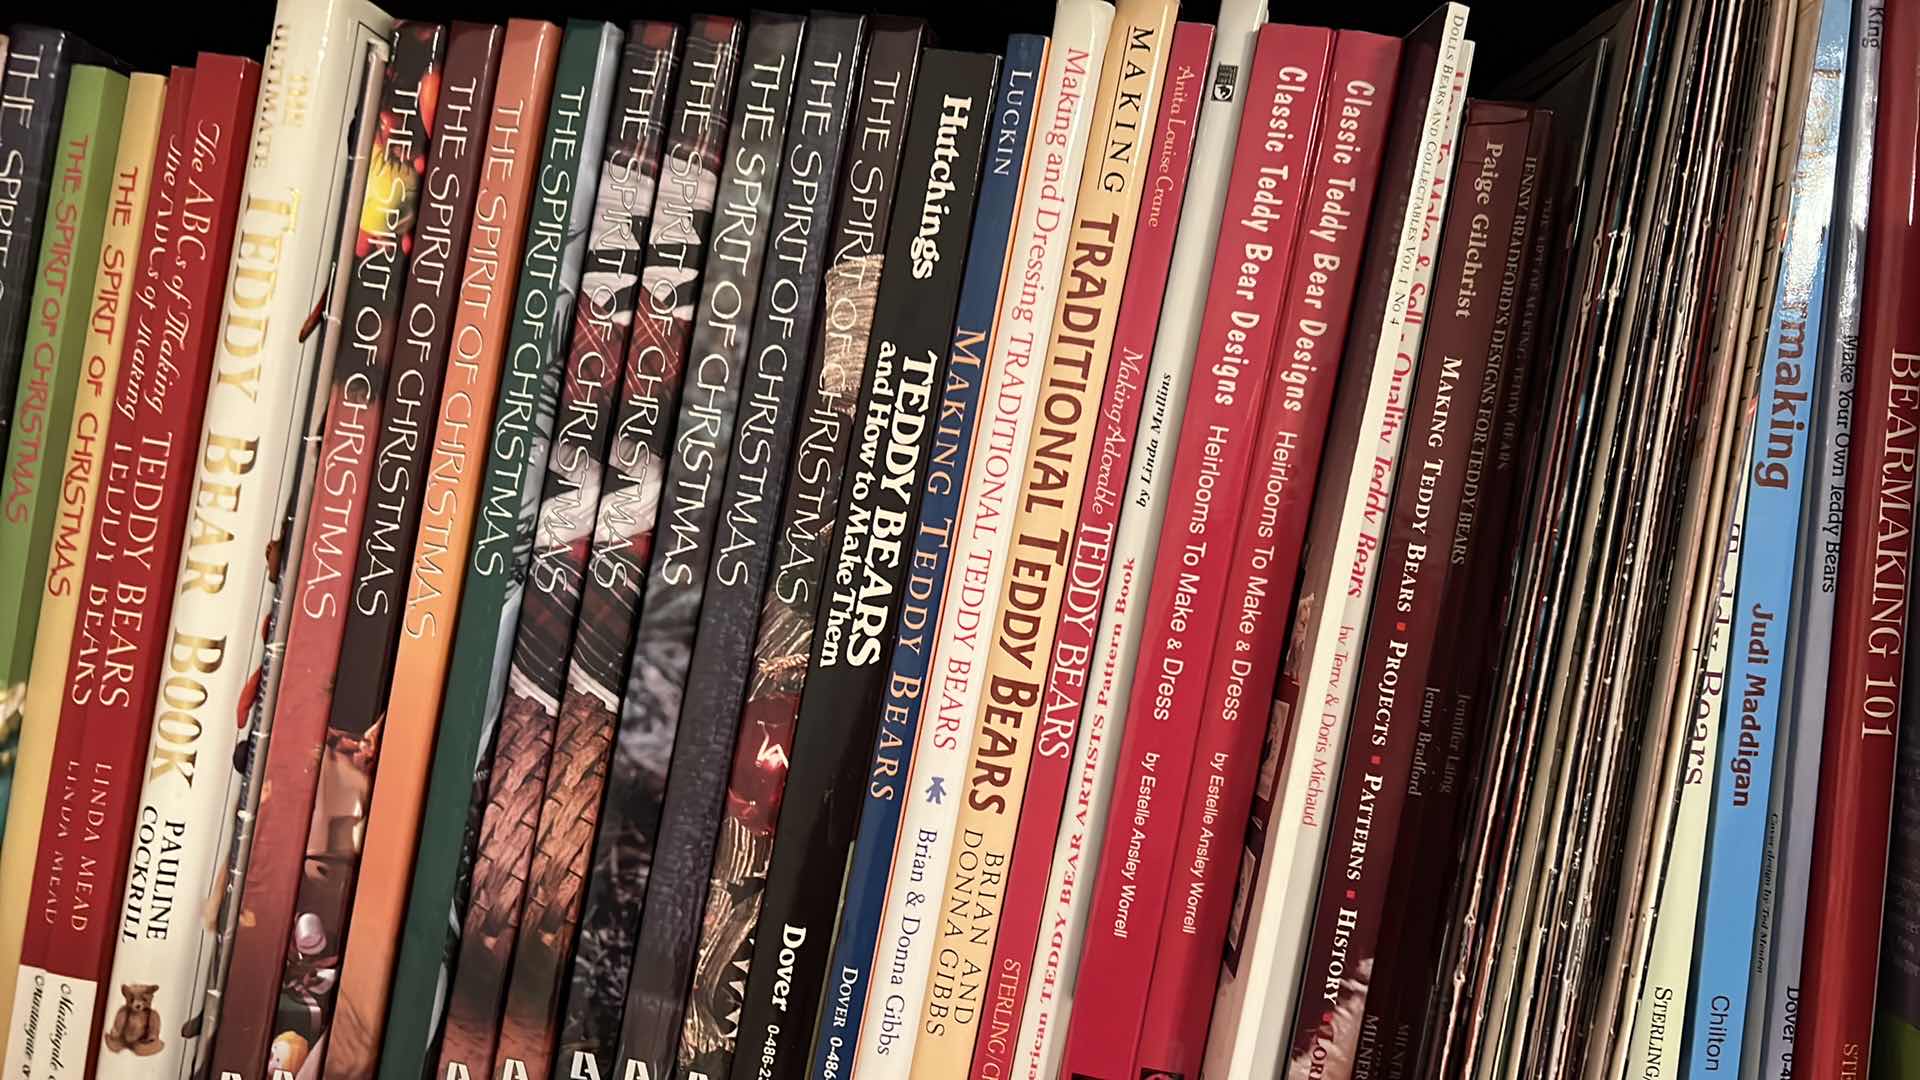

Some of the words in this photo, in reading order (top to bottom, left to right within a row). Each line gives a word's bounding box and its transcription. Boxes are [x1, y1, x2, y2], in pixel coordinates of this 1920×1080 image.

[1443, 15, 1464, 61] DOLLS
[1863, 7, 1885, 48] King
[387, 86, 422, 160] THE
[439, 78, 477, 159] THE
[552, 86, 585, 158] THE
[748, 55, 784, 143] THE
[993, 70, 1032, 175] LUCKIN
[1046, 46, 1090, 143] Making
[1103, 25, 1154, 194] MAKING
[1170, 65, 1195, 116] Anita
[1263, 65, 1307, 154] Classic
[1336, 79, 1375, 165] Classic
[1434, 65, 1455, 105] BEARS
[55, 136, 89, 192] THE
[190, 120, 220, 173] The
[487, 99, 524, 181] THE
[1041, 148, 1065, 205] and
[1160, 118, 1187, 174] Louise
[1471, 142, 1503, 205] Paige
[112, 167, 138, 228] THE
[714, 148, 767, 276] SPIRIT
[910, 94, 972, 279] Hutchings
[1150, 174, 1174, 228] Crane
[1242, 167, 1288, 233] Teddy
[1318, 171, 1358, 243] Teddy
[1407, 141, 1438, 242] COLLECTABLES
[41, 200, 77, 294] SPIRIT
[174, 177, 215, 273] ABCs
[358, 177, 407, 299] SPIRIT
[411, 168, 460, 295] SPIRIT
[461, 189, 507, 318] SPIRIT
[524, 165, 571, 289] SPIRIT
[89, 245, 125, 345] SPIRIT
[164, 276, 192, 310] of
[217, 192, 300, 403] TEDDY
[1011, 208, 1060, 321] Dressing
[1235, 244, 1273, 300] Bear
[1304, 252, 1340, 309] Bear
[1454, 212, 1491, 320] Gilchrist
[41, 298, 60, 334] OF
[355, 307, 382, 366] OF
[403, 303, 435, 359] OF
[521, 289, 549, 341] OF
[708, 280, 742, 348] OF
[83, 356, 105, 399] OF
[144, 310, 191, 413] Making
[455, 326, 484, 384] OF
[872, 341, 897, 394] and
[1025, 213, 1119, 512] TRADITIONAL
[1109, 348, 1143, 424] Making
[1212, 312, 1259, 407] Designs
[1282, 317, 1329, 412] Designs
[1480, 329, 1505, 404] DESIGNS
[1840, 334, 1858, 382] Make
[5, 341, 55, 525] CHRISTMAS
[858, 401, 895, 468] How
[881, 351, 938, 498] TEDDY
[927, 327, 987, 496] MAKING
[973, 334, 1034, 539] TRADITIONAL
[1151, 373, 1172, 434] Mullins
[1424, 356, 1462, 449] MAKING
[1475, 408, 1491, 443] FOR
[1837, 389, 1853, 425] Your
[476, 343, 541, 576] CHRISTMAS
[663, 353, 729, 586] CHRISTMAS
[853, 469, 877, 498] to
[1093, 425, 1127, 515] Adorable
[1140, 439, 1160, 483] Linda
[1190, 424, 1229, 536] Heirlooms
[1259, 430, 1297, 538] Heirlooms
[1461, 447, 1485, 509] TEDDY
[1833, 431, 1849, 467] Own
[47, 413, 99, 597] CHRISTMAS
[122, 432, 171, 569] TEDDY
[181, 430, 257, 594] BEAR
[304, 372, 371, 619] CHRISTMAS
[356, 369, 425, 616] CHRISTMAS
[405, 392, 473, 640] CHRISTMAS
[1136, 488, 1151, 507] by
[1412, 458, 1445, 534] TEDDY
[1821, 471, 1844, 536] Teddy
[1868, 350, 1919, 669] BEARMAKING
[834, 502, 868, 584] Make
[1184, 545, 1206, 569] To
[1250, 545, 1274, 570] To
[1451, 511, 1470, 565] BEARS
[1823, 540, 1839, 593] Bears
[845, 502, 902, 667] BEARS
[898, 519, 953, 655] TEDDY
[951, 548, 992, 652] TEDDY
[999, 525, 1071, 670] TEDDY
[1062, 522, 1113, 637] TEDDY
[1167, 574, 1200, 634] Make
[1235, 576, 1267, 641] Make
[1397, 544, 1426, 613] BEARS
[101, 581, 147, 708] BEARS
[820, 589, 858, 667] Them
[1749, 603, 1775, 665] Judi
[150, 633, 227, 790] BOOK
[933, 658, 972, 751] BEARS
[1039, 641, 1089, 758] BEARS
[1154, 659, 1183, 721] Dress
[1223, 660, 1252, 721] Dress
[1371, 641, 1409, 747] PROJECTS
[1420, 687, 1440, 727] Jenny
[1861, 675, 1895, 740] 101
[872, 672, 921, 801] BEARS
[968, 674, 1039, 816] BEARS
[1145, 752, 1159, 771] by
[1214, 752, 1229, 772] by
[1315, 713, 1337, 756] Doris
[1408, 732, 1432, 796] Bradford
[1732, 673, 1768, 808] Maddigan
[82, 763, 112, 844] LINDA
[1041, 911, 1067, 1006] TEDDY
[1058, 831, 1083, 906] BEAR
[1074, 715, 1105, 827] ARTISTS
[1096, 622, 1122, 707] Pattern
[1115, 558, 1135, 618] Book
[1130, 775, 1157, 825] Estelle
[1198, 775, 1224, 827] Estelle
[1302, 759, 1327, 827] Michaud
[909, 829, 937, 883] Brian
[1122, 828, 1147, 881] Ansley
[1190, 831, 1216, 877] Ansley
[1347, 773, 1382, 881] PATTERNS
[71, 858, 96, 931] MEAD
[122, 805, 158, 944] COCKRILL
[147, 820, 186, 940] PAULINE
[904, 892, 925, 906] &
[944, 829, 983, 939] DONNA
[970, 852, 1004, 945] BRIAN
[1113, 885, 1134, 939] Worrell
[1183, 883, 1208, 934] Worrell
[771, 924, 806, 1012] Dover
[890, 915, 921, 985] Donna
[1323, 907, 1358, 1007] HISTORY
[49, 984, 74, 1071] Martingale
[831, 967, 858, 1027] DOVER
[876, 993, 905, 1055] Gibbs
[925, 948, 959, 1037] GIBBS
[954, 960, 983, 1025] AND
[1783, 986, 1799, 1041] Dover
[1705, 995, 1729, 1071] Chilton
